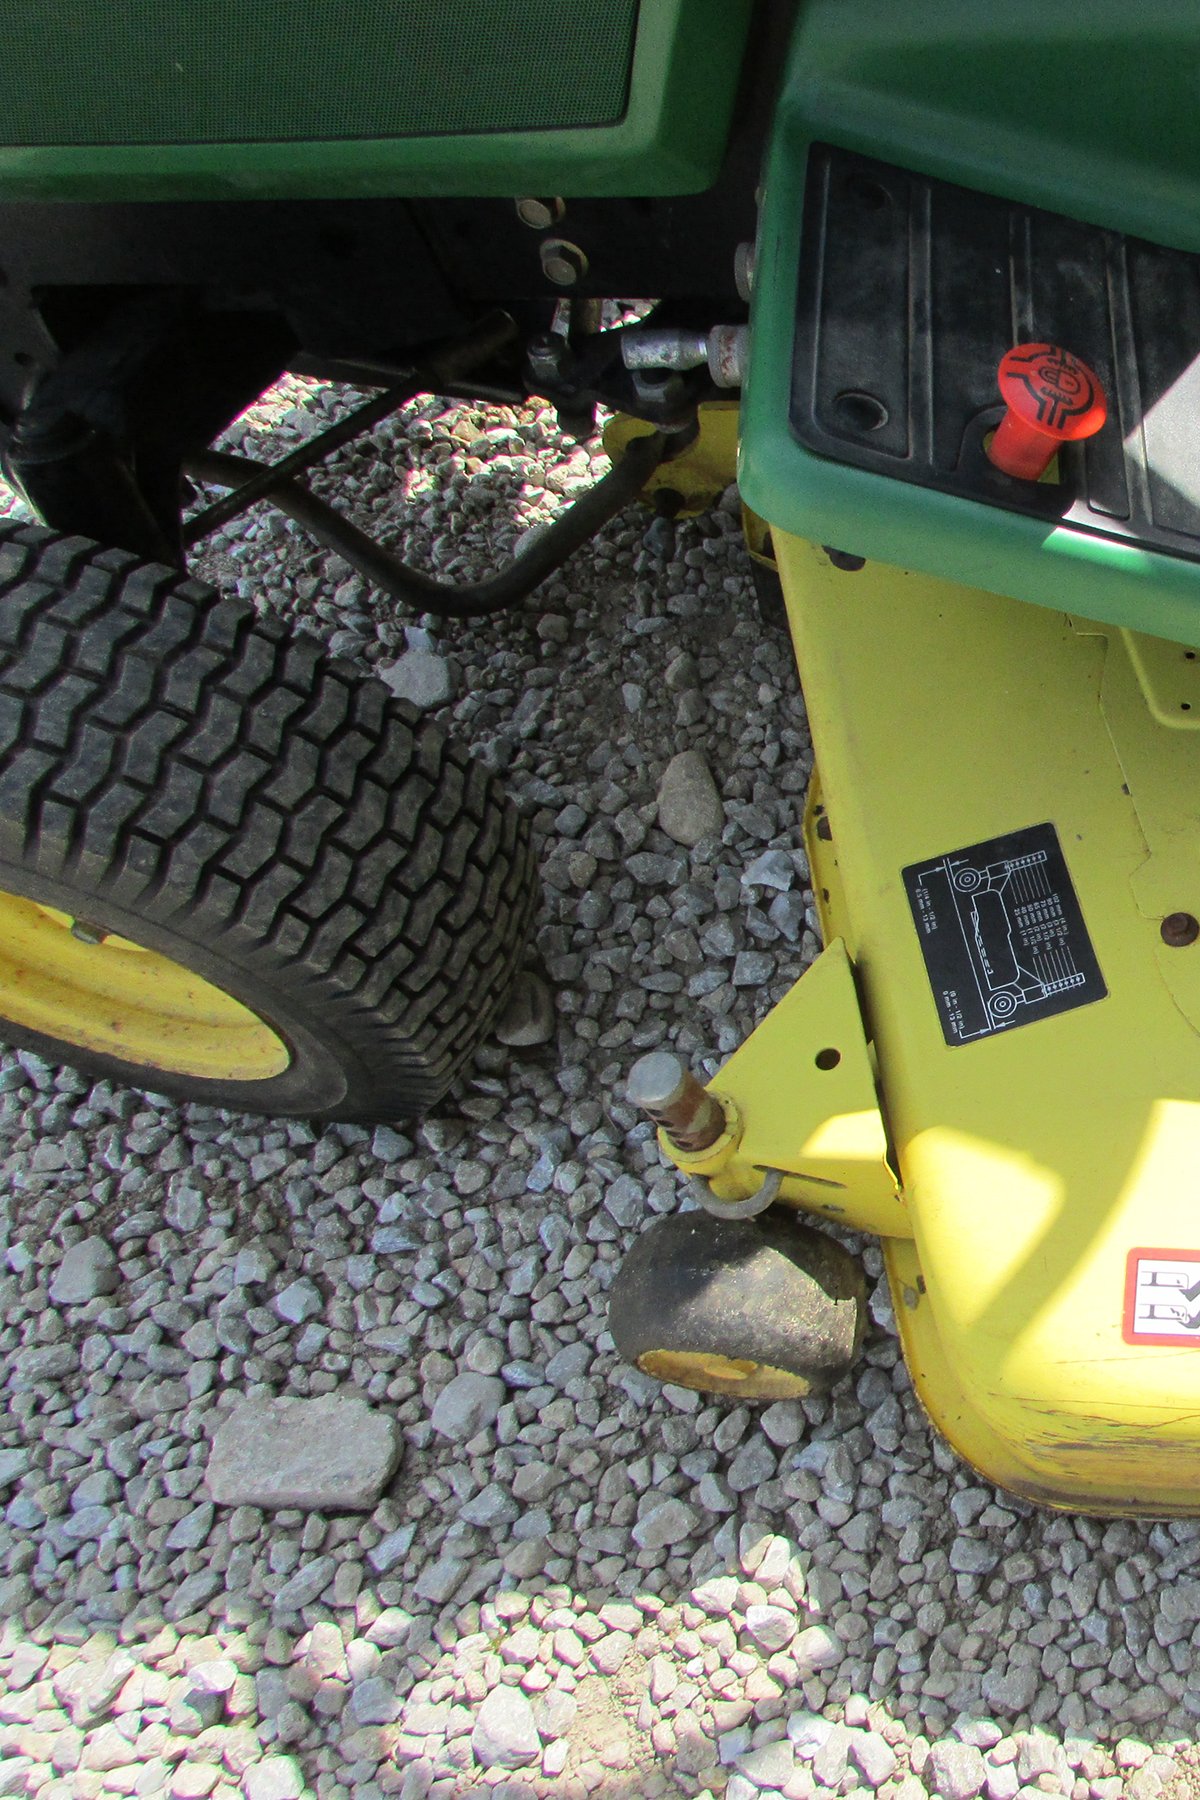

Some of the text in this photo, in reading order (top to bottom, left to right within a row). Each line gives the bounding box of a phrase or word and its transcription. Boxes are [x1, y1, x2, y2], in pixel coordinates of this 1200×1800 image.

[1042, 908, 1049, 919] mm
[1049, 906, 1055, 917] mm
[1055, 904, 1062, 915] mm
[917, 898, 924, 909] mm
[924, 922, 931, 933] mm
[1023, 914, 1029, 925] mm
[1029, 912, 1036, 923] mm
[1035, 910, 1042, 921] mm
[1016, 916, 1023, 928] mm
[944, 995, 951, 1007] mm
[950, 1021, 958, 1033] mm
